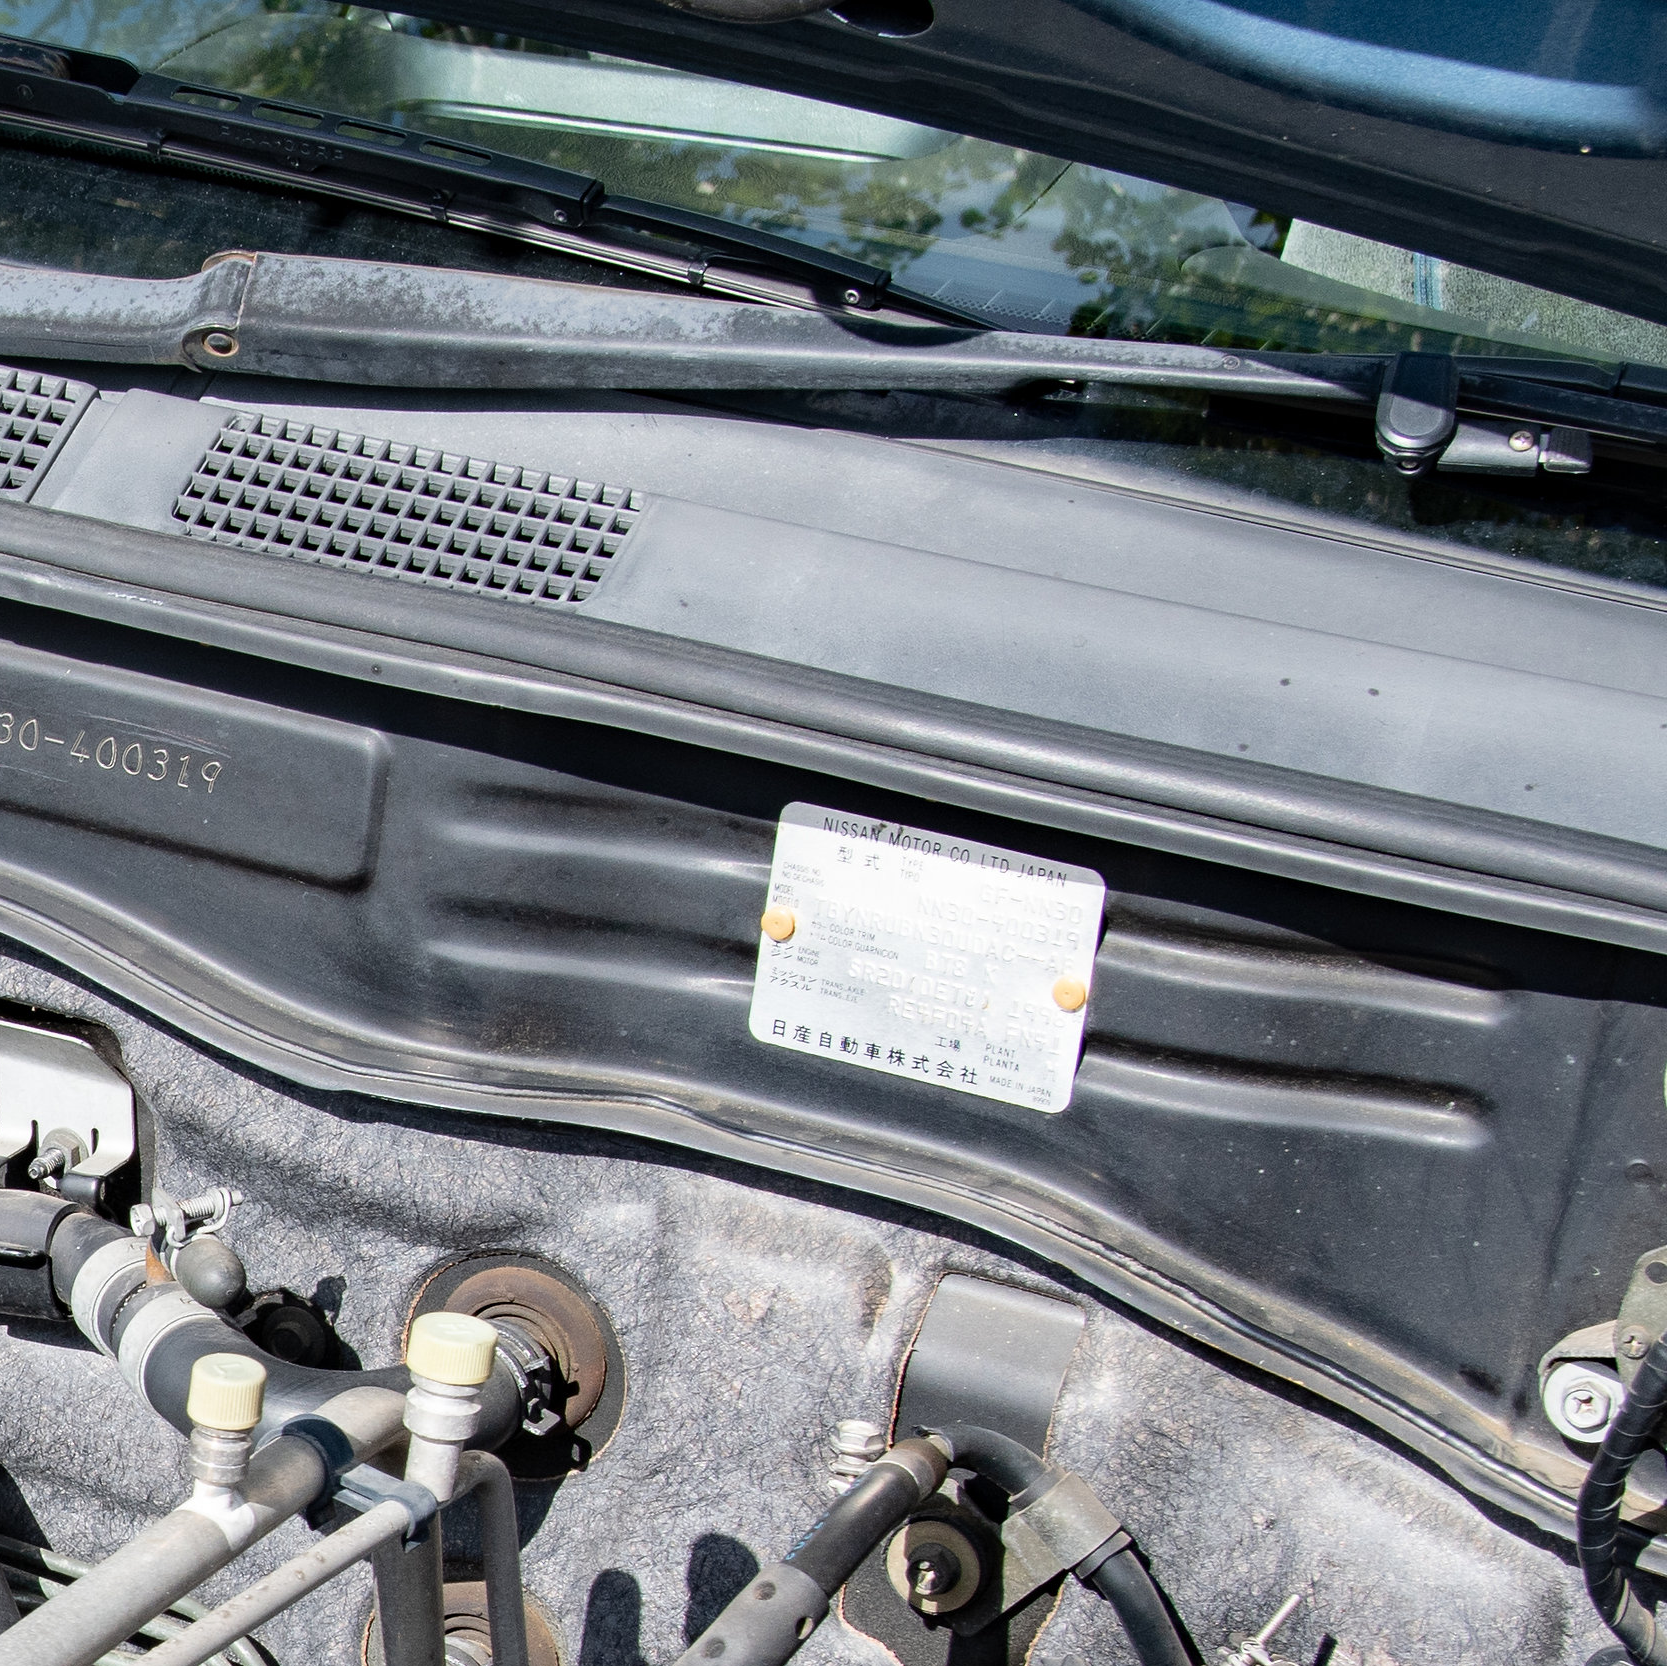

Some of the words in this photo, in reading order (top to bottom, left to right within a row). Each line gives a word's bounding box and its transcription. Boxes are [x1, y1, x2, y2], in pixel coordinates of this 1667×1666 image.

[823, 817, 881, 842] NISSAN
[889, 832, 941, 856] MOTOR
[771, 1018, 979, 1086] 日産自動車株式会社
